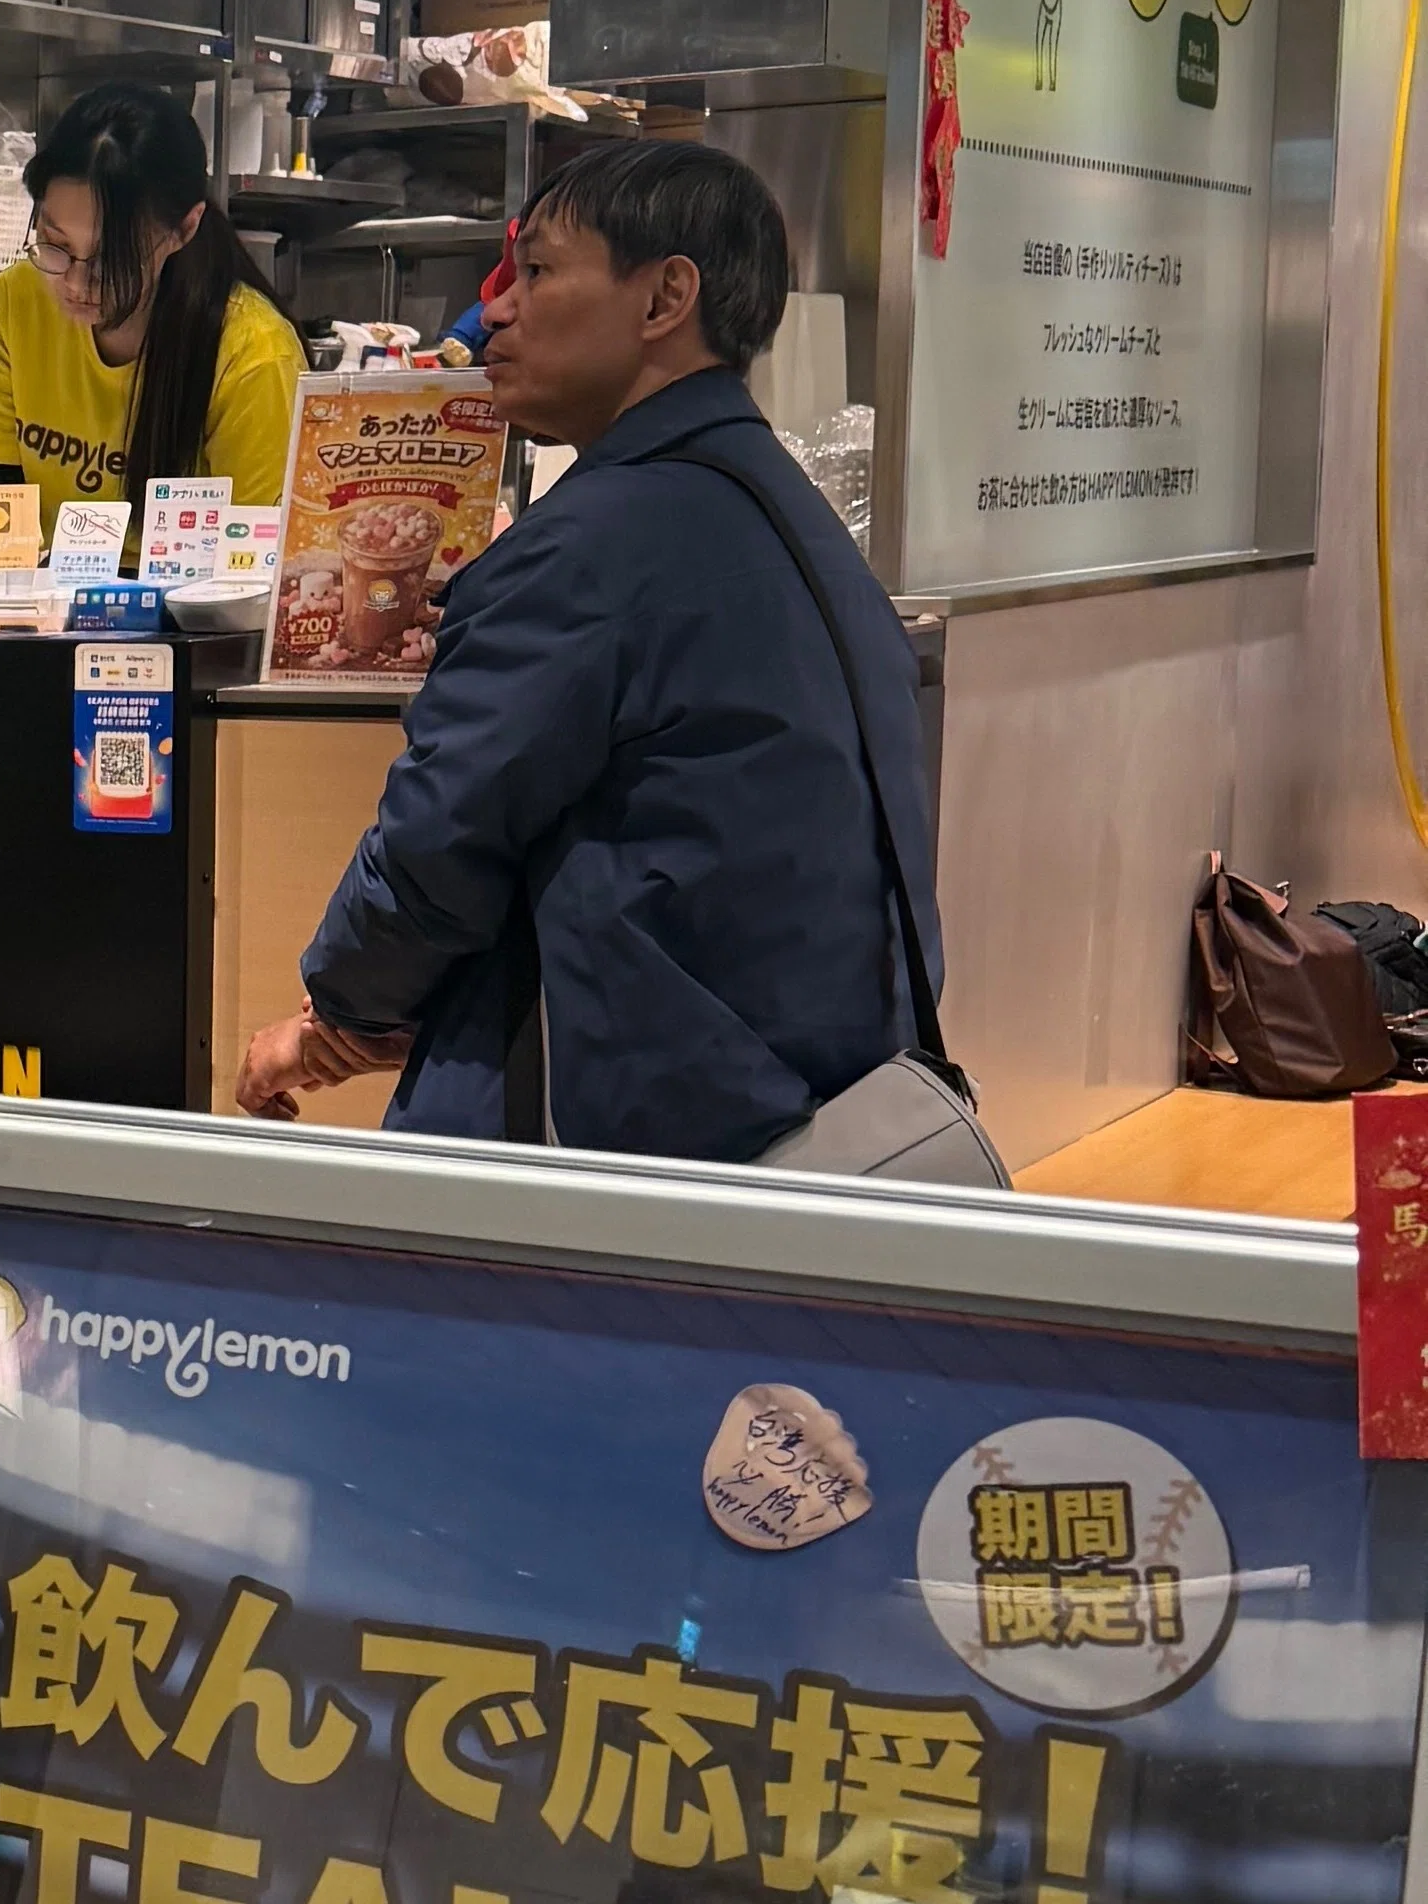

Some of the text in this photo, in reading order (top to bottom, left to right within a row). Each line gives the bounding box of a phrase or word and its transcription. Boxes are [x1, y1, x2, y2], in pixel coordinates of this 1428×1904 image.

[359, 413, 443, 438] あったか
[317, 440, 487, 469] マシュマロココア
[42, 1295, 351, 1398] happylemon
[972, 1484, 1132, 1564] 期間
